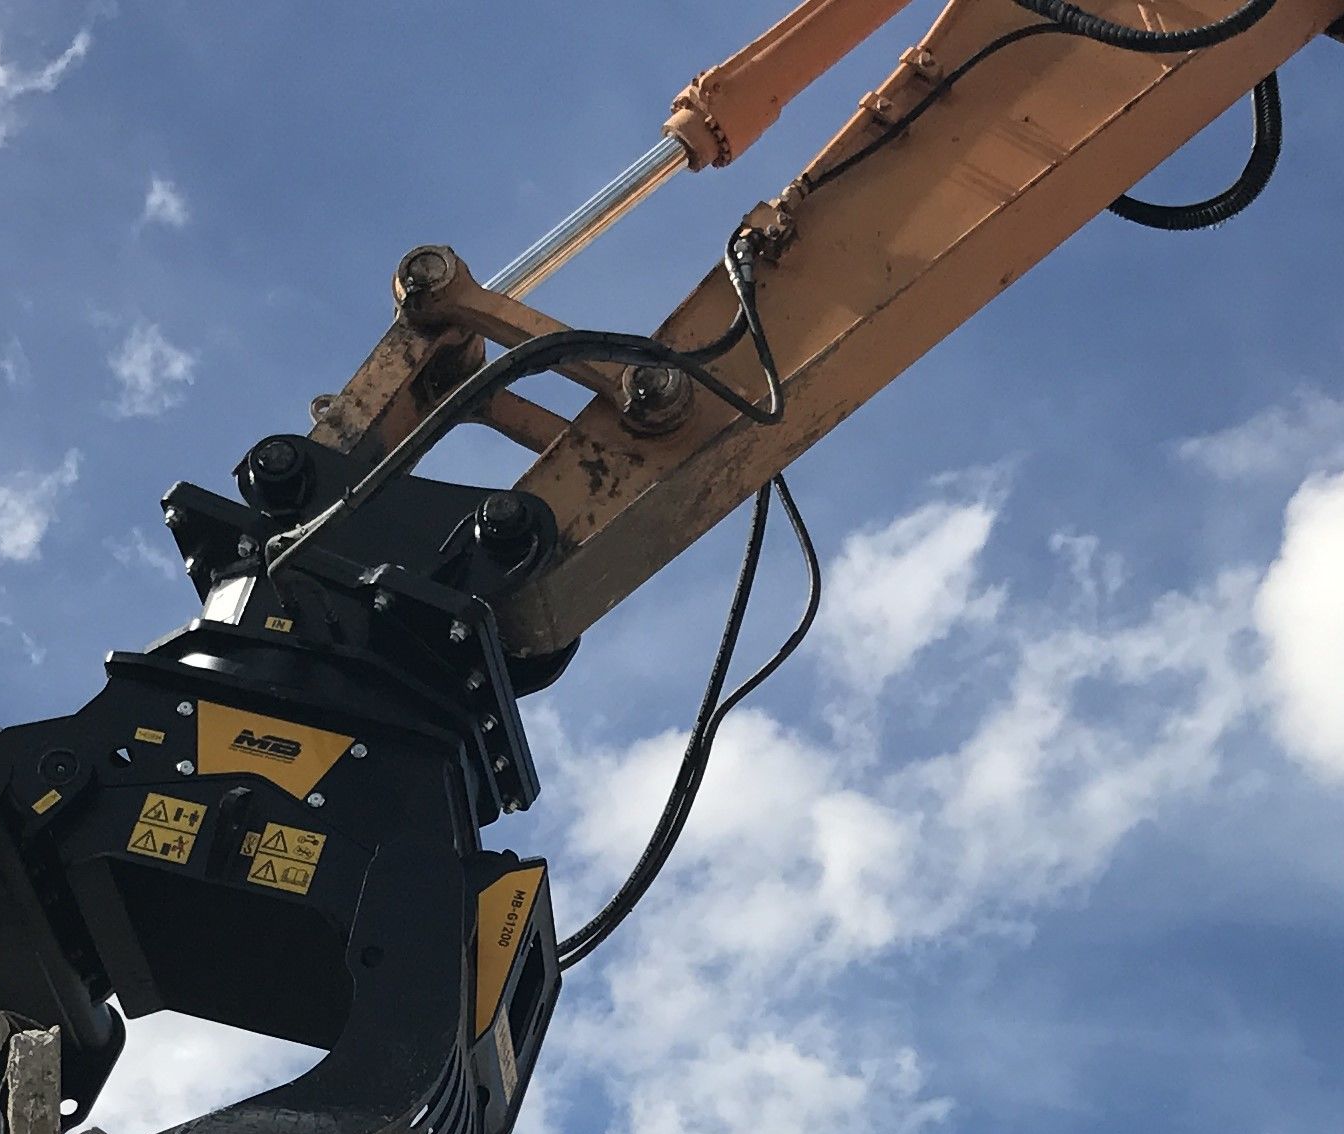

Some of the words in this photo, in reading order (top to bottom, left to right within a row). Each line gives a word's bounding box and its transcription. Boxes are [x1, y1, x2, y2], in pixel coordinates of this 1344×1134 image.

[271, 620, 286, 630] IN
[233, 729, 302, 757] MB
[497, 890, 526, 947] MB-G1200
